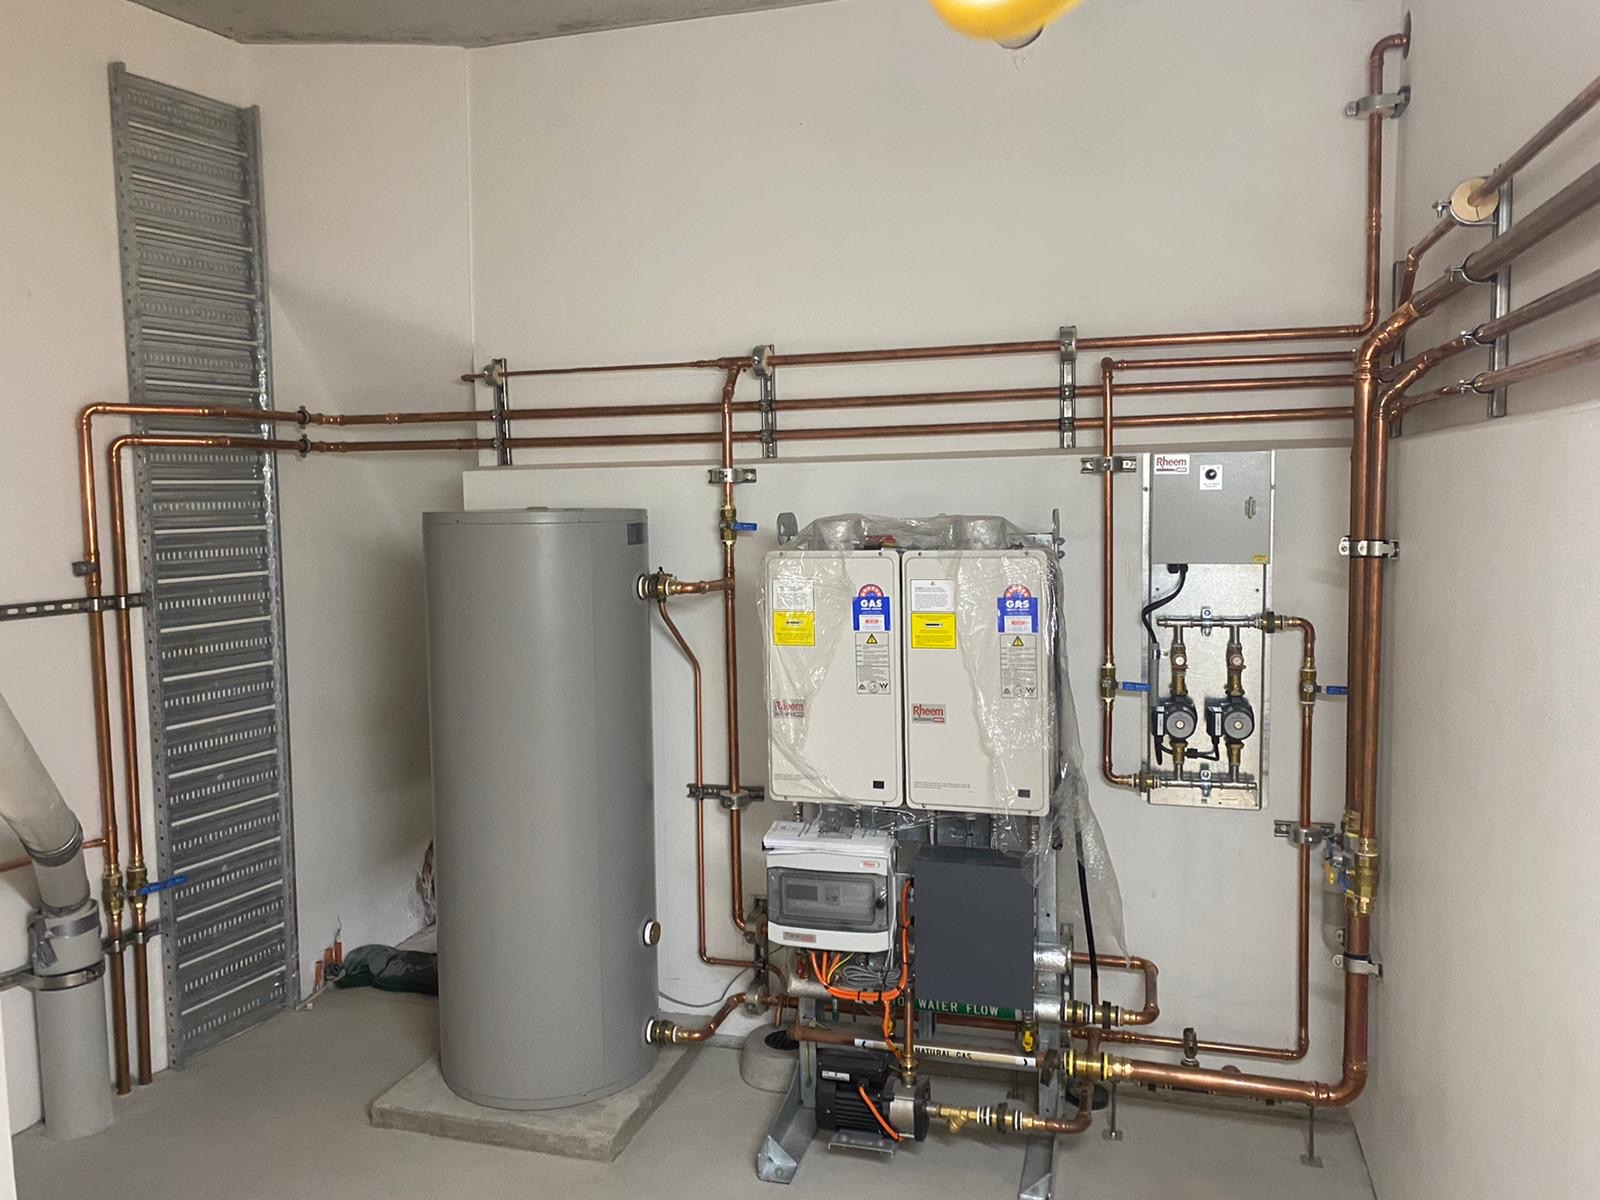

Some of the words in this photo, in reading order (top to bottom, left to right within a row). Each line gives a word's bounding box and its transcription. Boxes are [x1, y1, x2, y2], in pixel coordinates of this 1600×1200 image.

[1156, 456, 1187, 468] Rheem
[860, 599, 882, 608] GAS
[1005, 599, 1029, 608] GAS
[912, 703, 944, 717] Rheem
[918, 999, 958, 1012] WATER
[966, 1003, 999, 1016] FLOW
[915, 1047, 950, 1057] NATURAL
[956, 1051, 972, 1060] GAS
